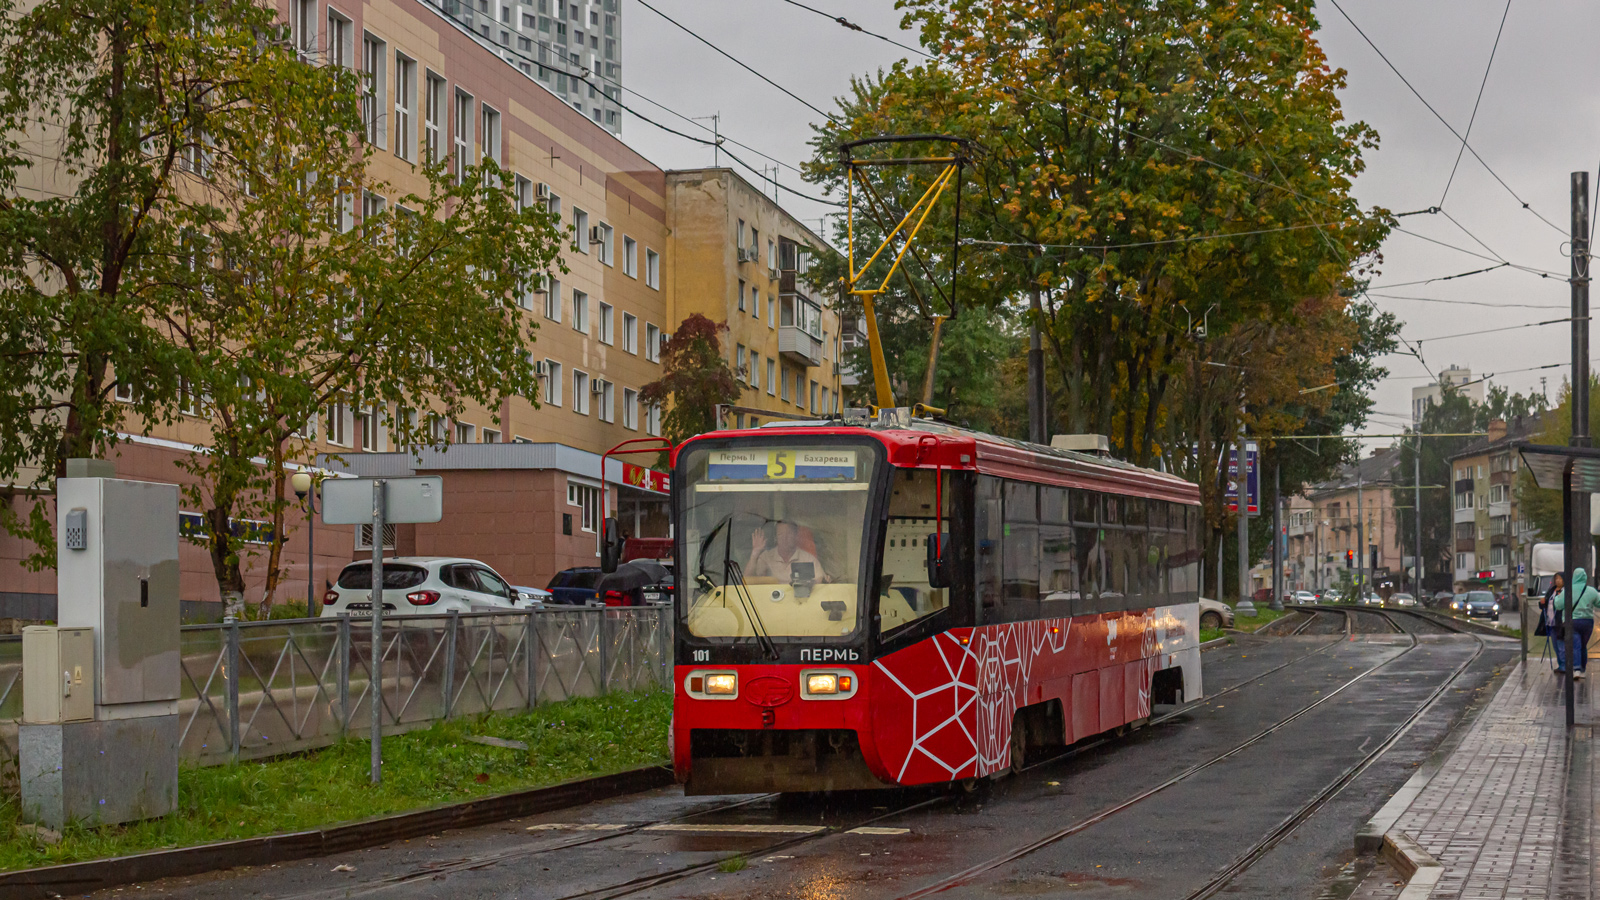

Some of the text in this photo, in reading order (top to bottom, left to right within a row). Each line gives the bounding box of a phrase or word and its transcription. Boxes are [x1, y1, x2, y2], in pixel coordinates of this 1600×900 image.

[720, 453, 748, 463] Пермь
[803, 454, 849, 465] Бахаревка
[773, 452, 788, 477] 5
[692, 650, 710, 662] 101
[800, 649, 860, 662] ПЕРМЬ
